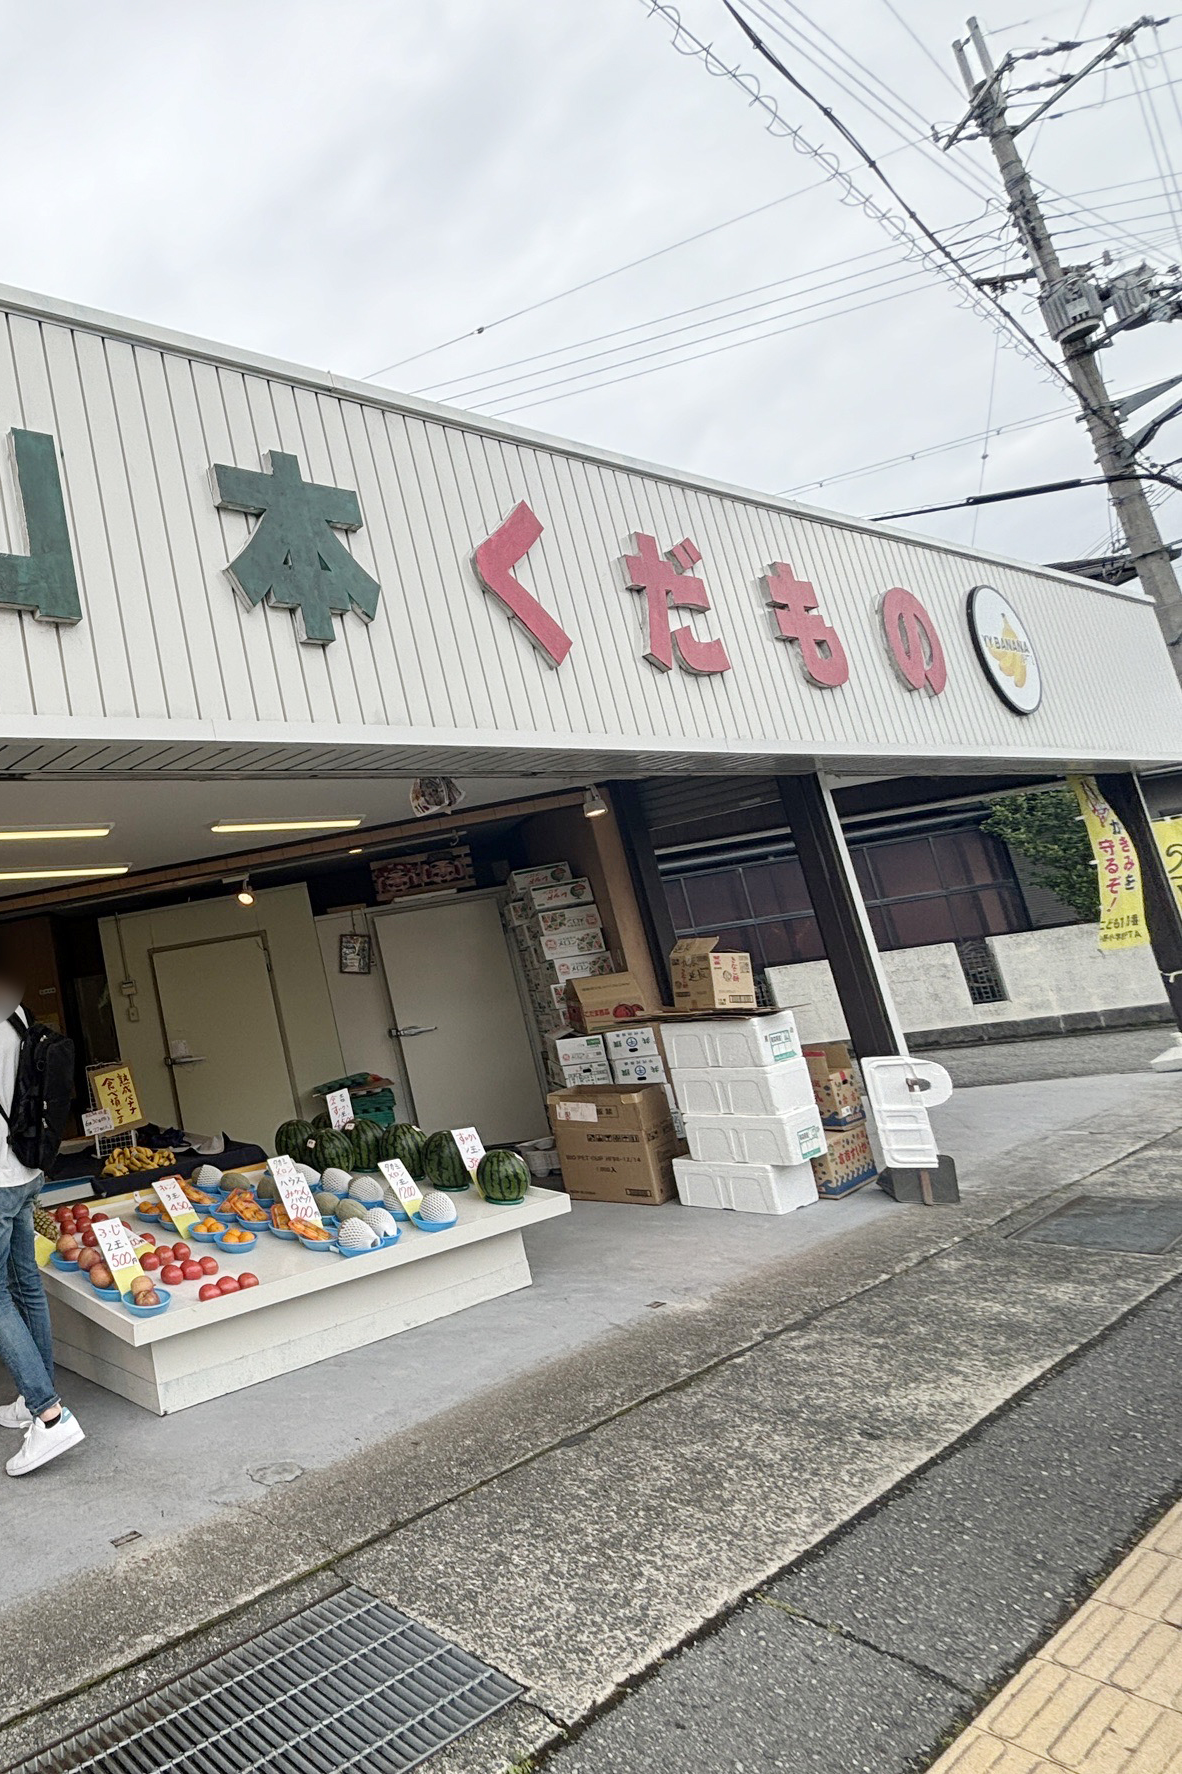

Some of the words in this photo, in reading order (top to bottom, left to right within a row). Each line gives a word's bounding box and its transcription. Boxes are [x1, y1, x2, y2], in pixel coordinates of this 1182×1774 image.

[994, 638, 1030, 653] BANANA
[398, 1185, 416, 1200] 1200
[111, 1251, 138, 1268] 500円
